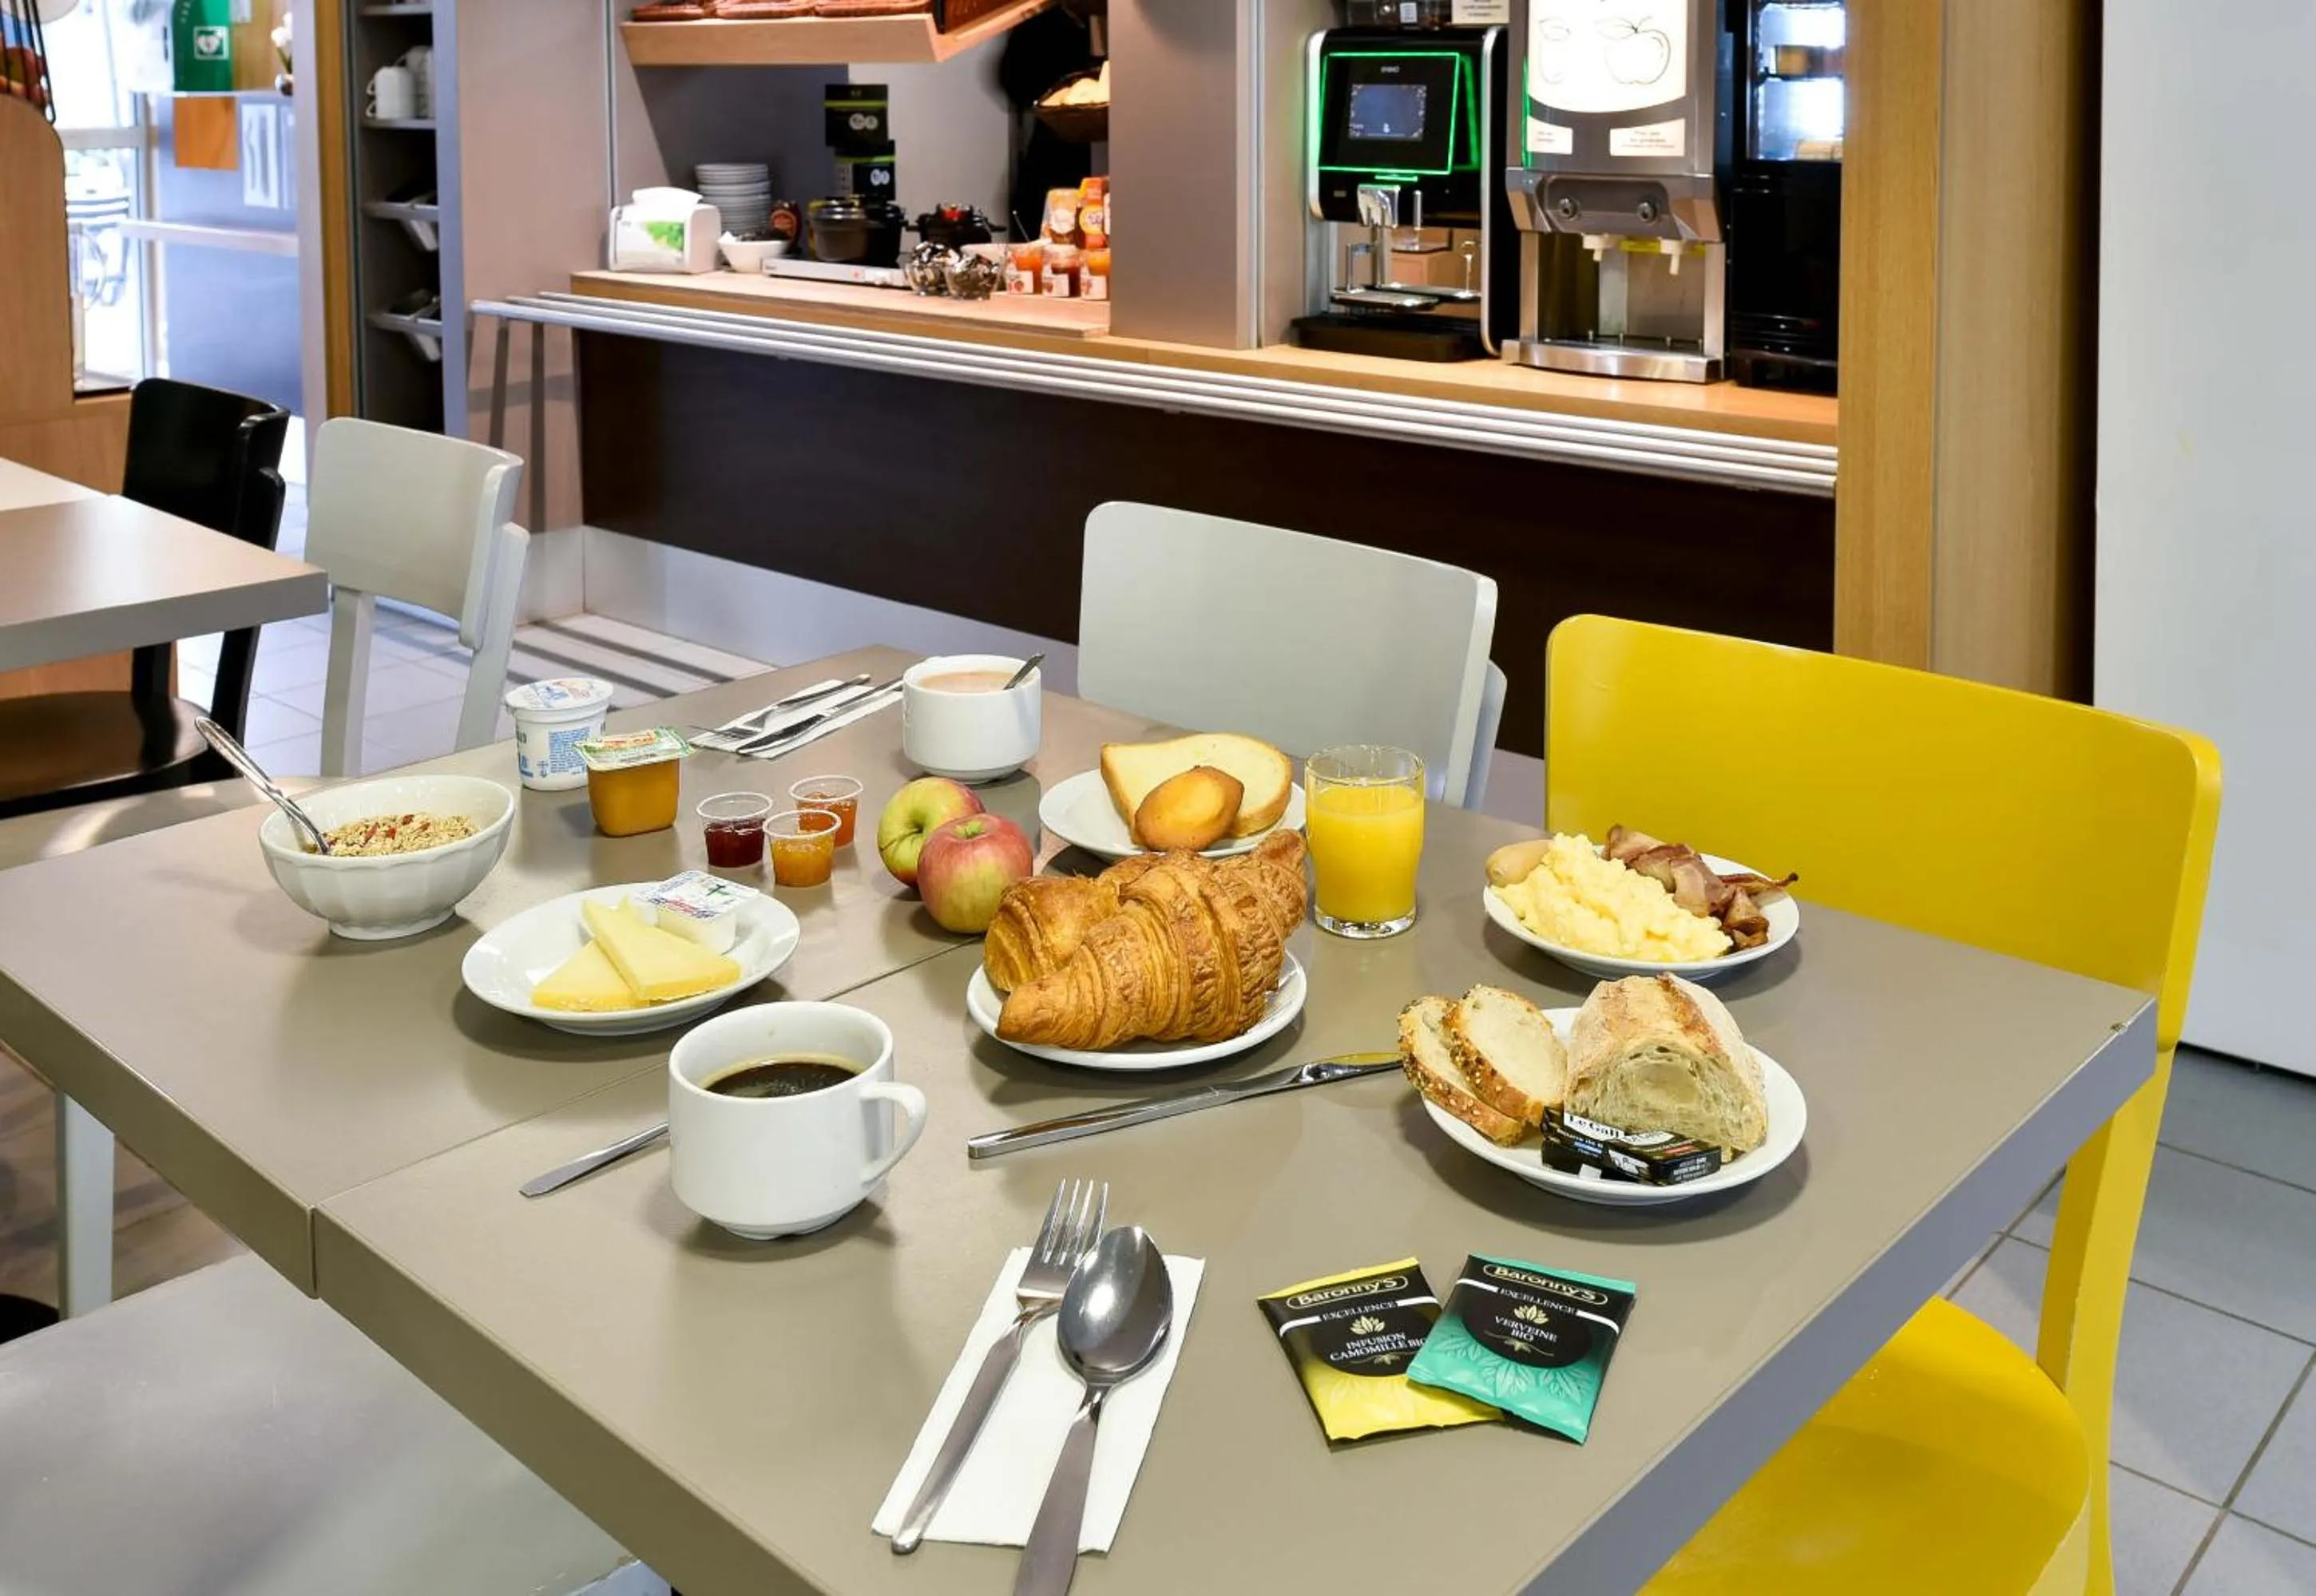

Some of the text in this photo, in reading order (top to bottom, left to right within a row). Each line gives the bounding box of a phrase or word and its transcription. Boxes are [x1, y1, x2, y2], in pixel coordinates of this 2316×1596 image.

[1500, 1288, 1576, 1313] EXCELLENCE
[1322, 1301, 1395, 1321] EXCELLENCE
[1495, 1316, 1557, 1342] VERVEINE
[1511, 1329, 1534, 1342] BIO
[1330, 1341, 1408, 1361] CAMOMILLE
[1346, 1332, 1406, 1350] INFUSION
